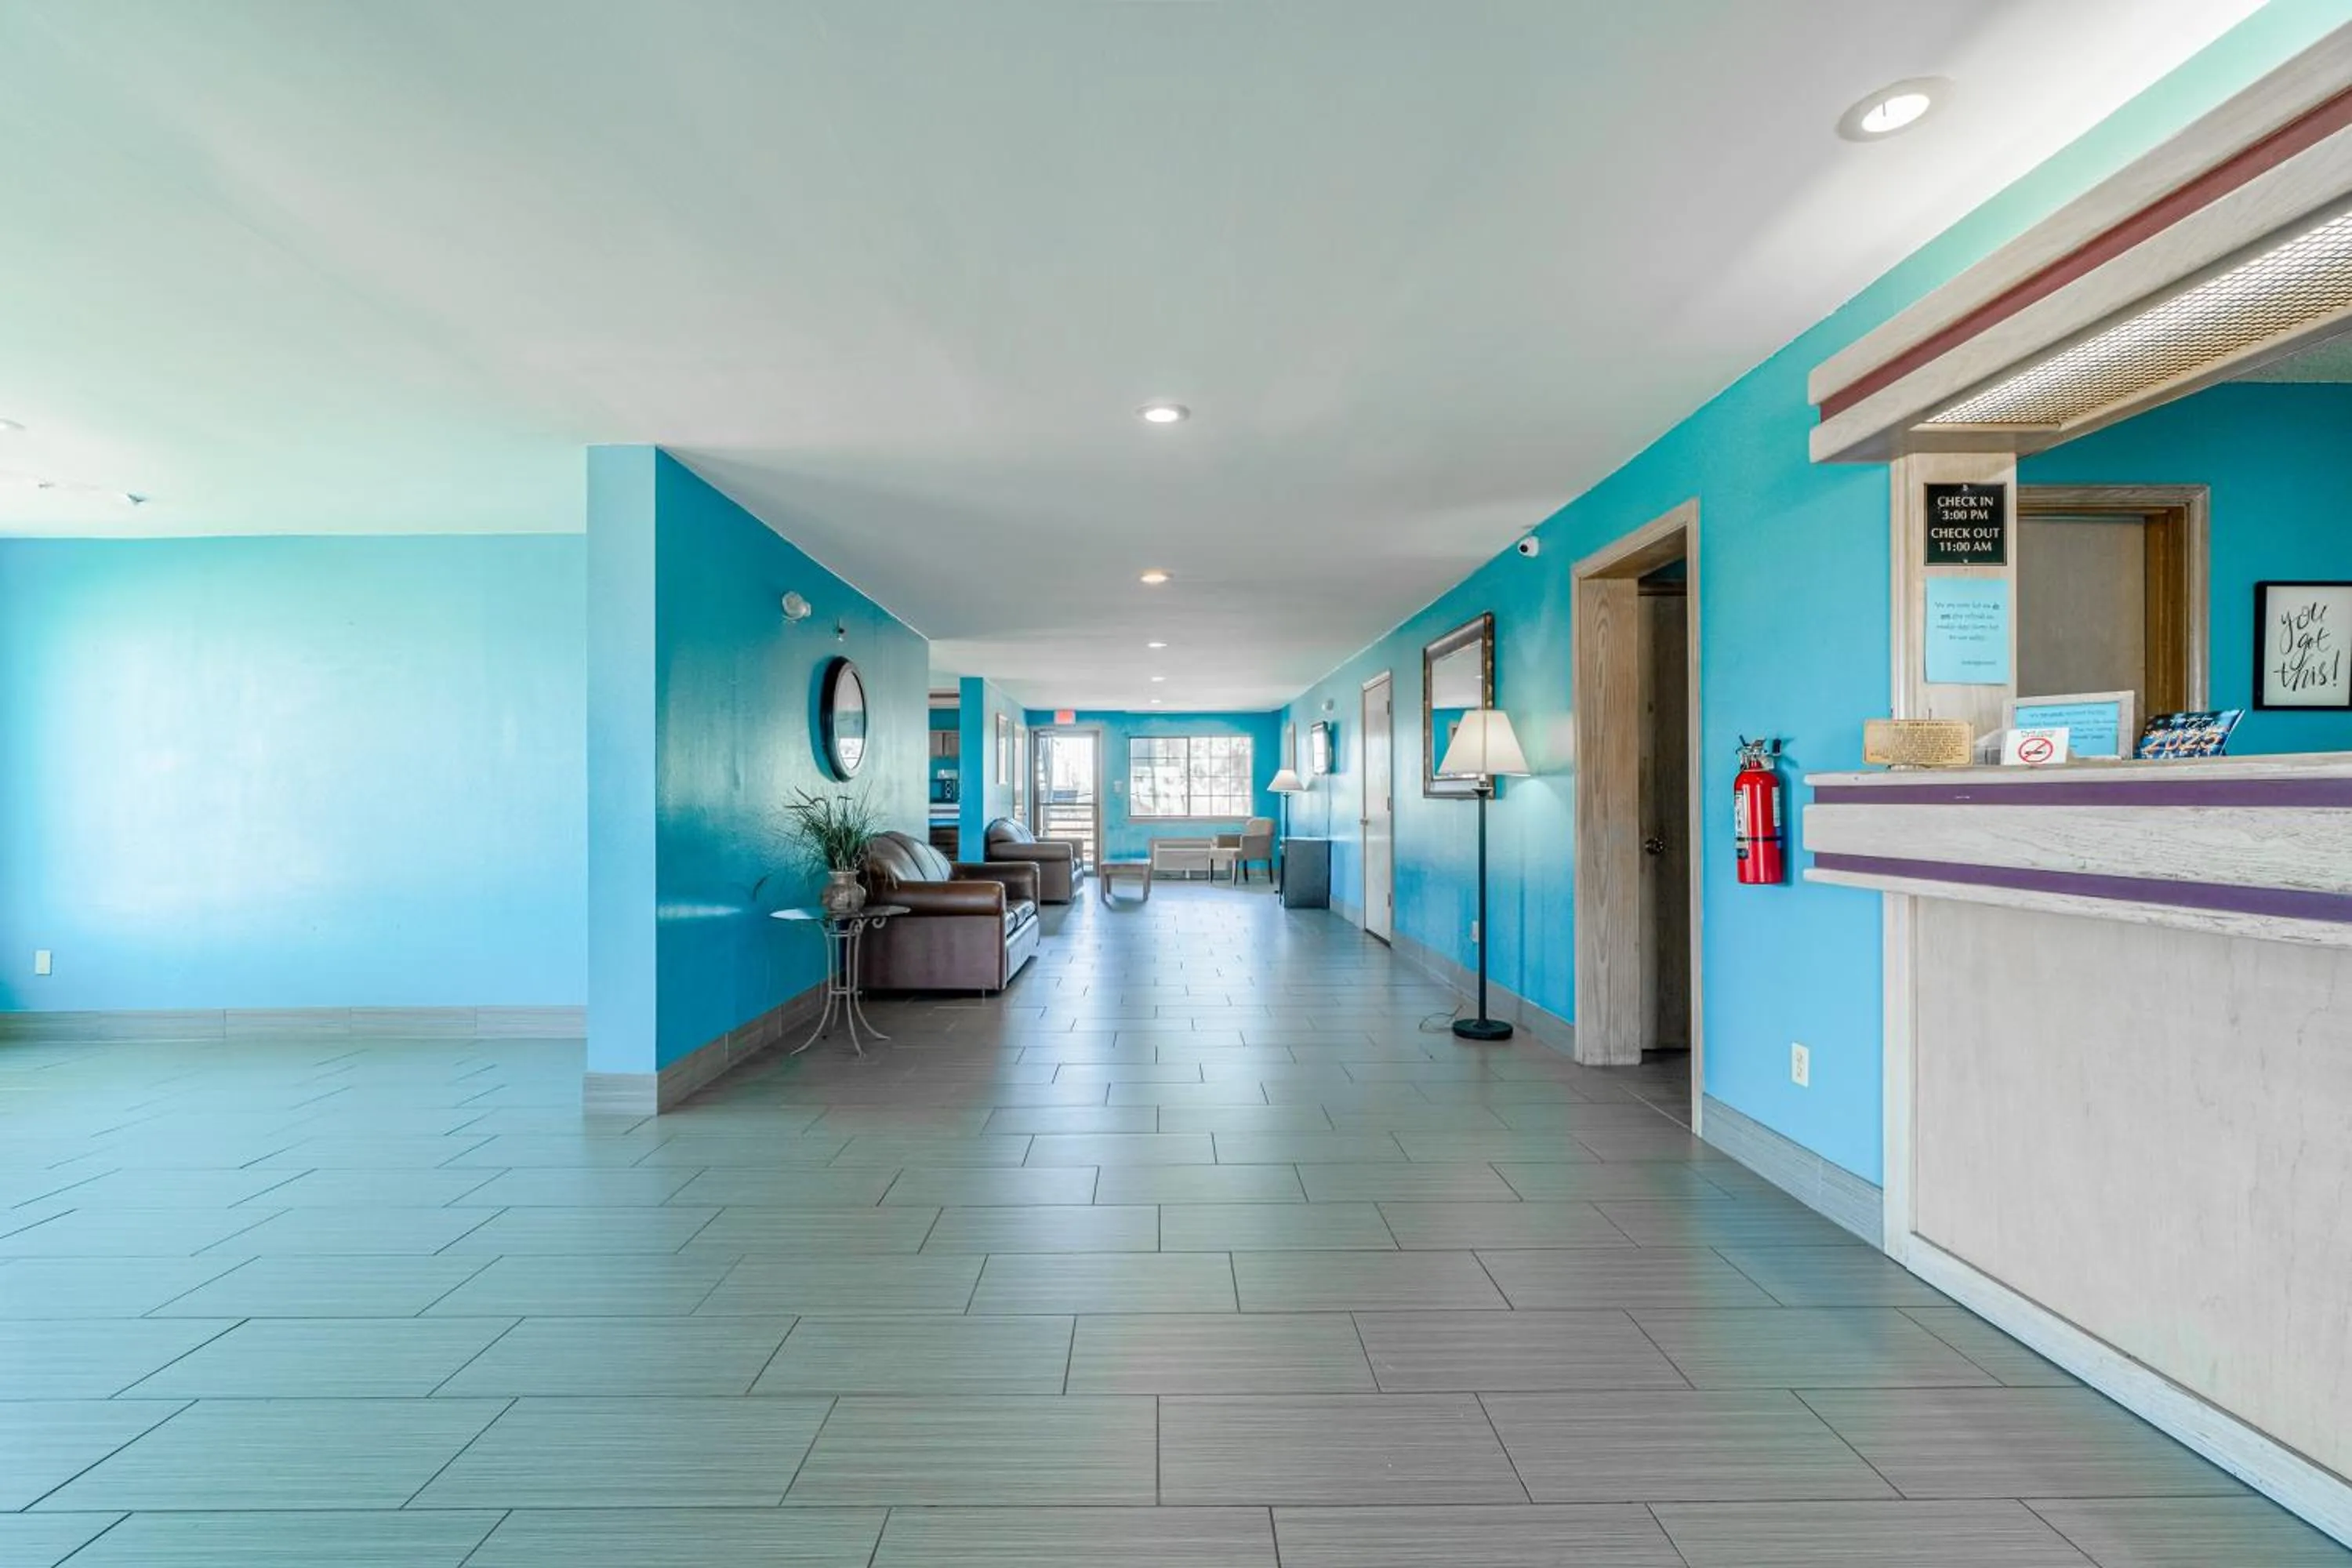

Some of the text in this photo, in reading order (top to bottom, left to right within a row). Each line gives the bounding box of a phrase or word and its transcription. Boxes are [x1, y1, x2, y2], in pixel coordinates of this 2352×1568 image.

[1937, 496, 1994, 507] CHECK IN
[1942, 510, 1989, 521] 3:00 PM
[1931, 528, 2000, 539] CHECK OUT
[1939, 542, 1992, 552] 11:00 AM
[2280, 601, 2328, 655] you
[2289, 627, 2332, 672] got
[2273, 649, 2340, 692] this!
[2143, 728, 2223, 753] 2025
